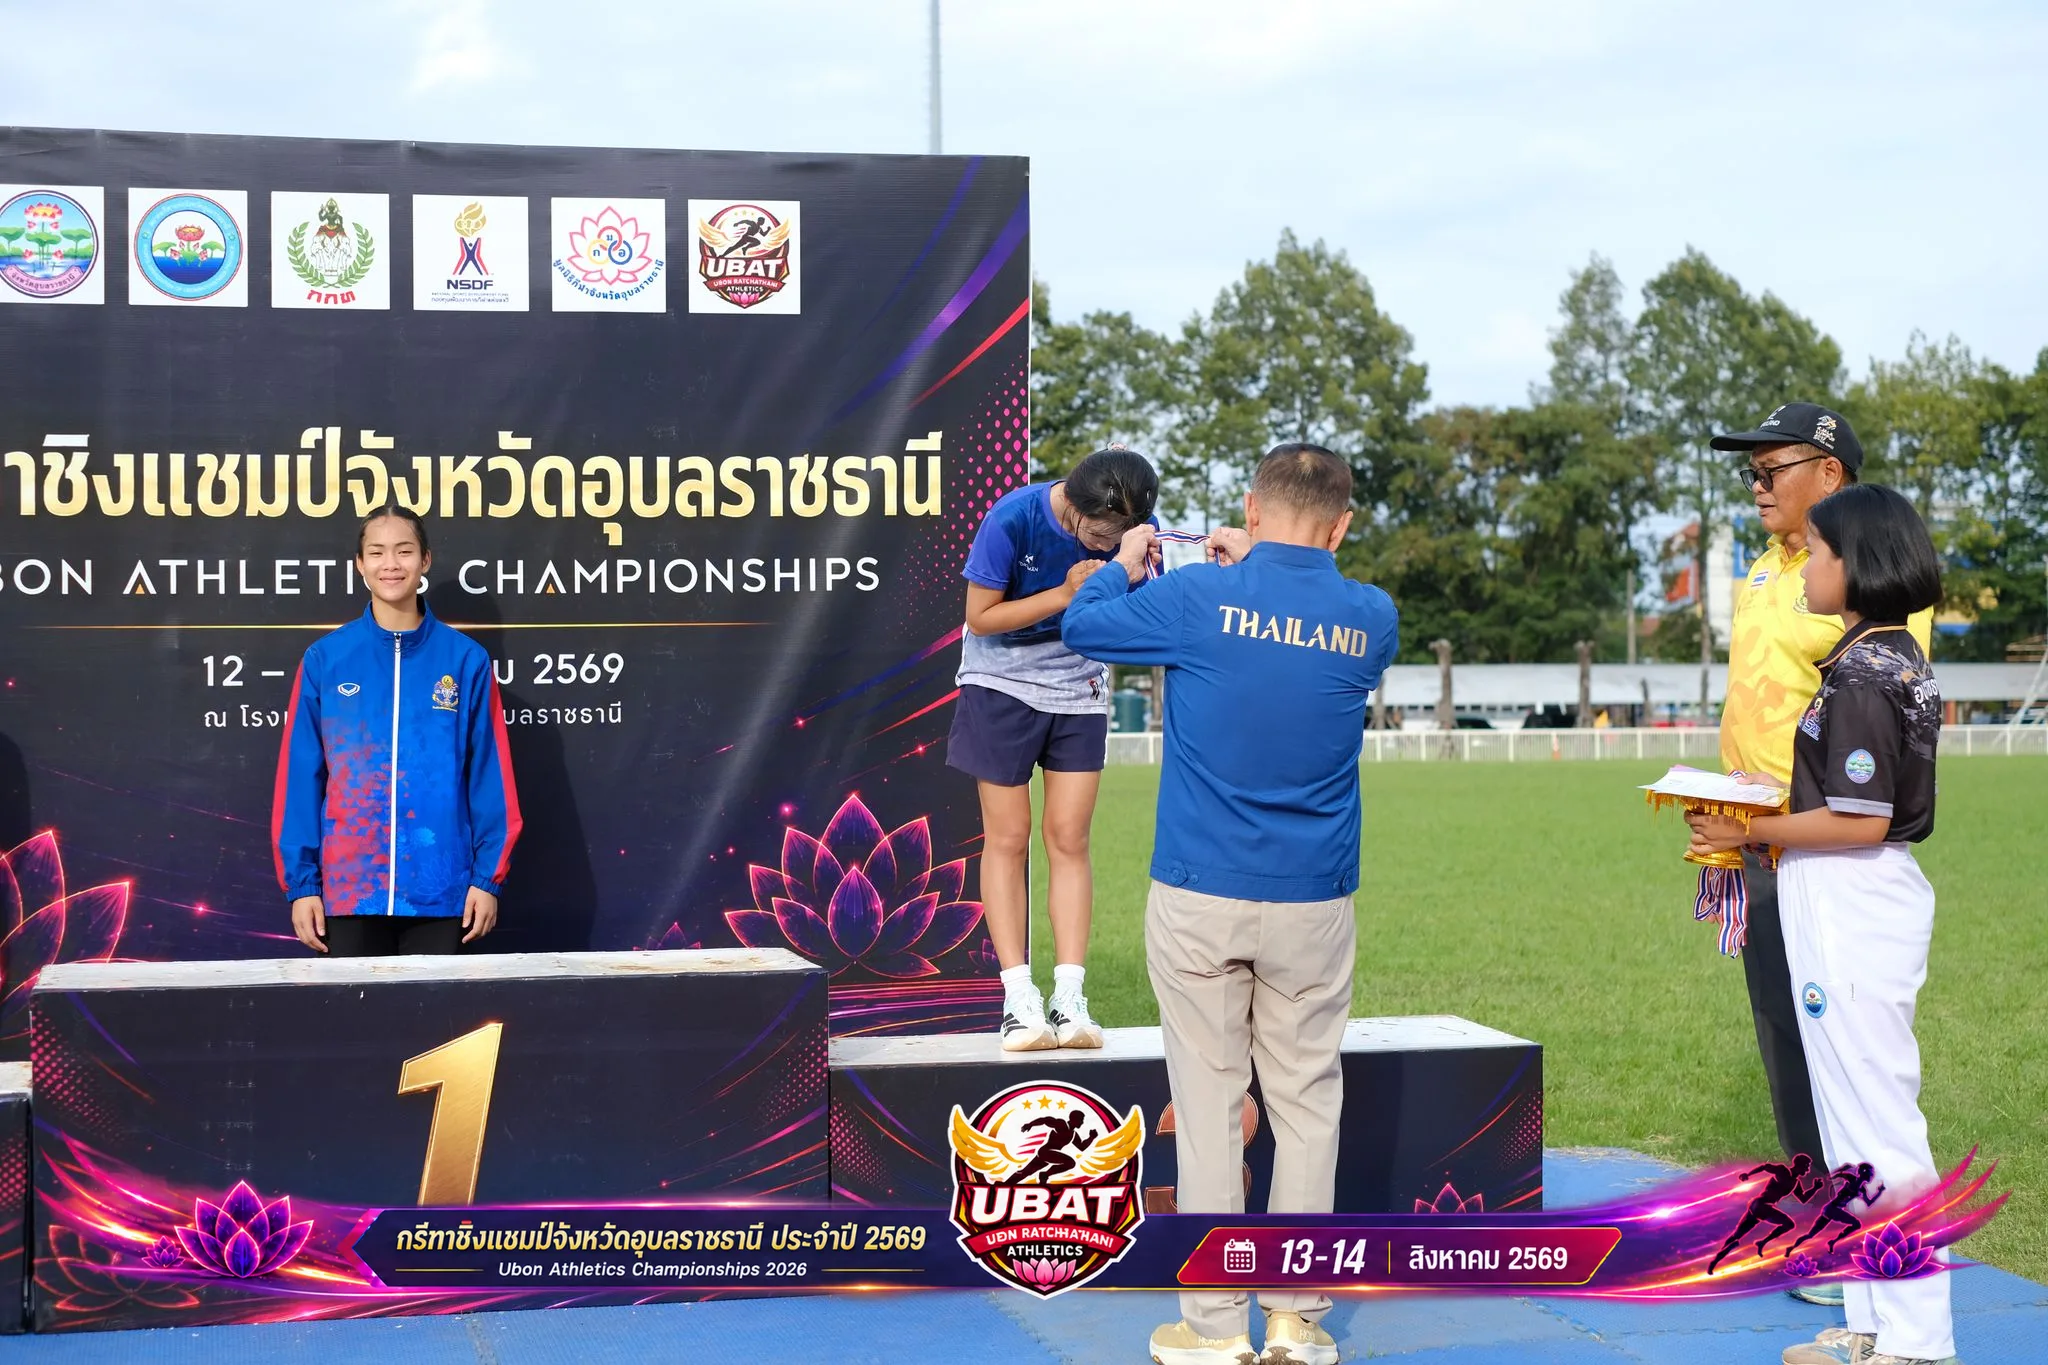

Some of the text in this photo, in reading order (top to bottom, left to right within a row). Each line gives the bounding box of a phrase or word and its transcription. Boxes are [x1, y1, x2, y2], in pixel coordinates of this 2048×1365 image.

[446, 279, 494, 291] NSDF
[706, 257, 783, 278] UBAT
[0, 556, 880, 596] ON ATHLETI CHAMPIONSHIPS
[1219, 605, 1368, 658] THAILAND
[203, 655, 244, 687] 12
[533, 652, 625, 685] 2569
[204, 710, 227, 728] ณ
[397, 1022, 504, 1206] 1
